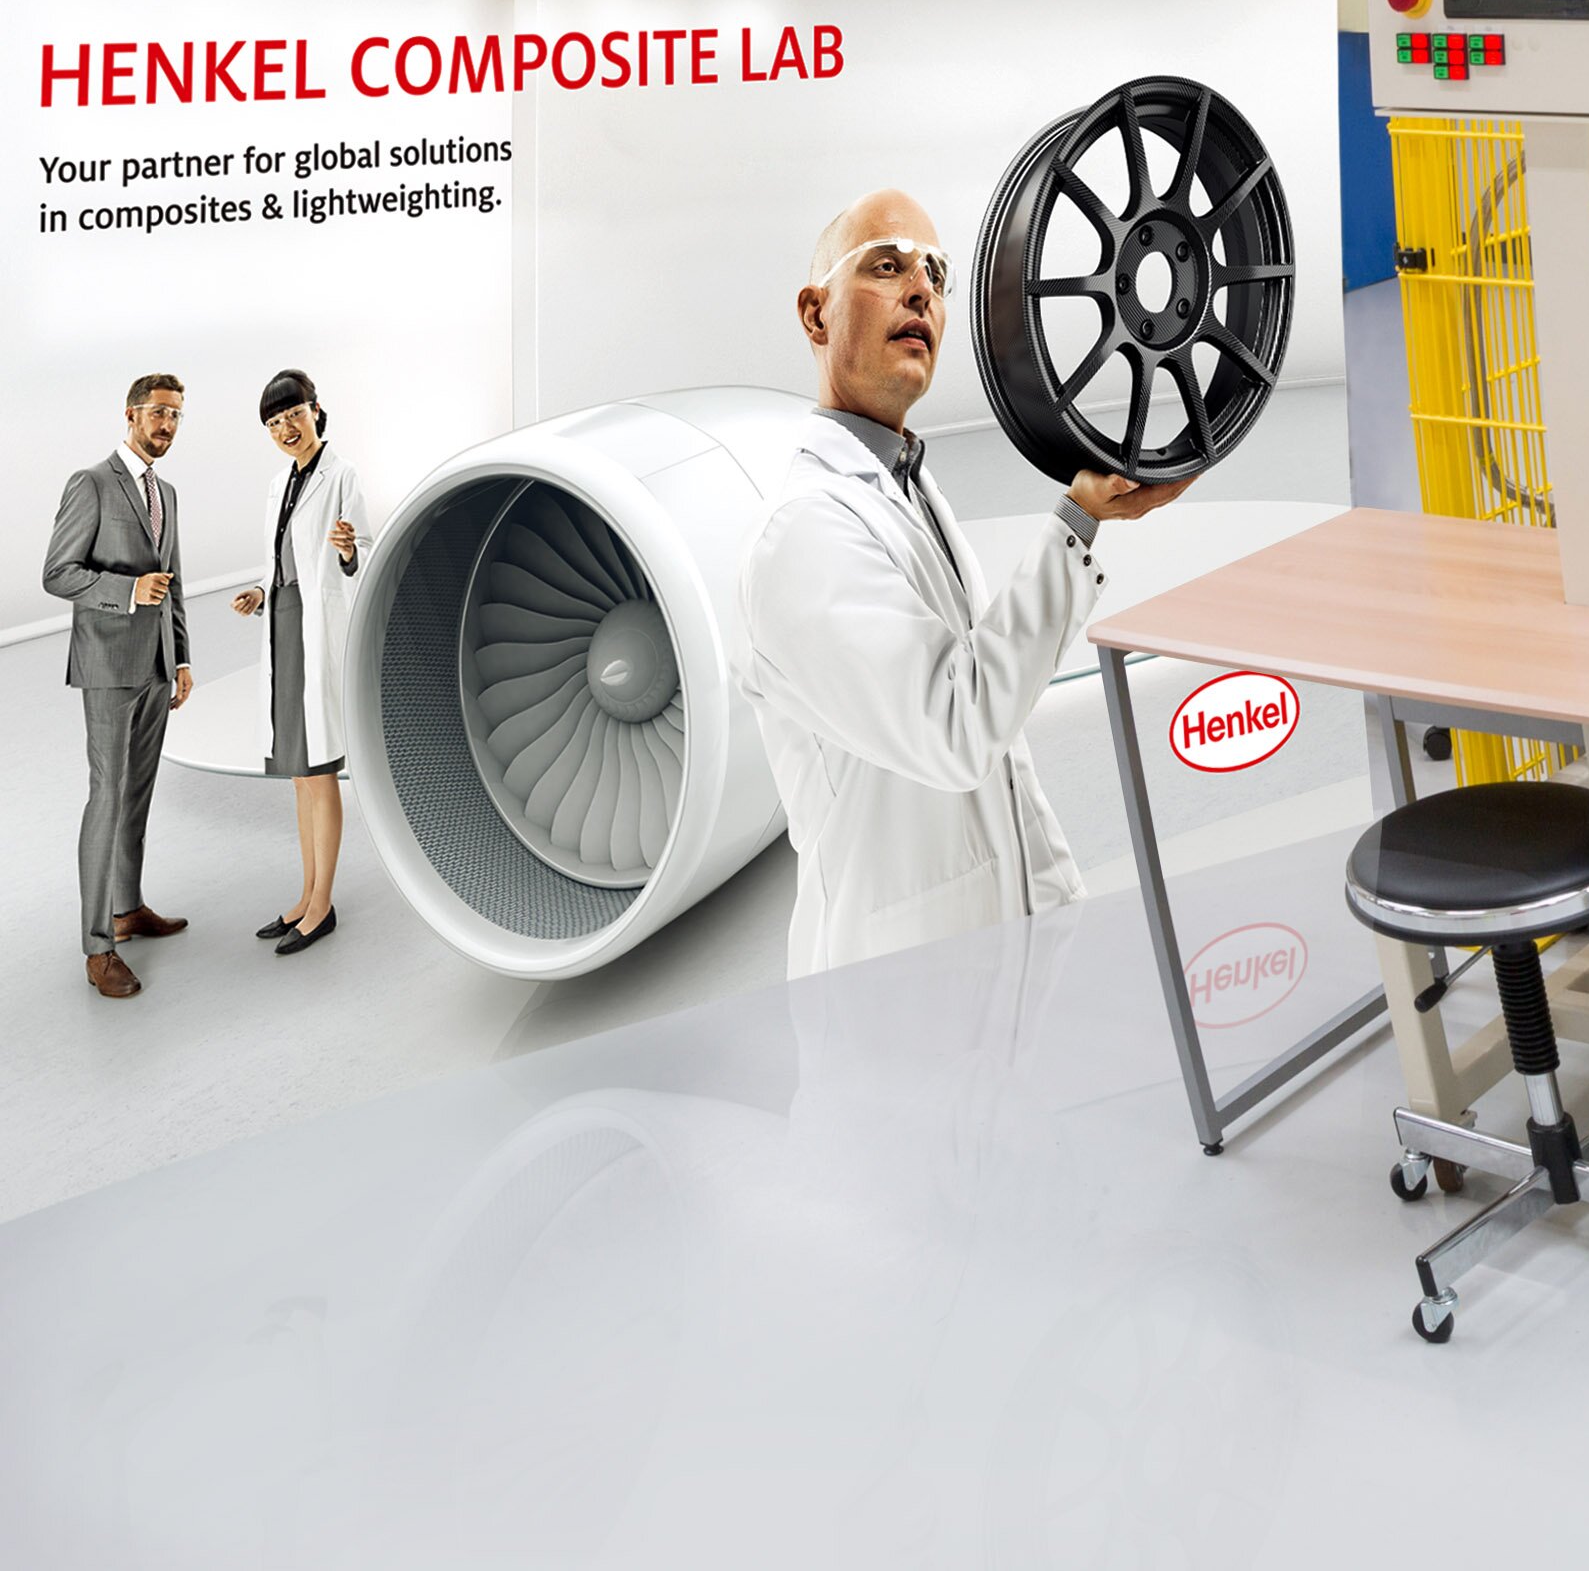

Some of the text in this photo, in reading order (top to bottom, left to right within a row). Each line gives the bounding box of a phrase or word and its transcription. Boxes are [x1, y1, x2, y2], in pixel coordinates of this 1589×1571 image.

[40, 24, 845, 108] HENKEL COMPOSITE LAB
[39, 135, 512, 188] Your partner for global solutions
[40, 180, 502, 234] in composites & lightweighting.
[1182, 691, 1290, 749] Henkel
